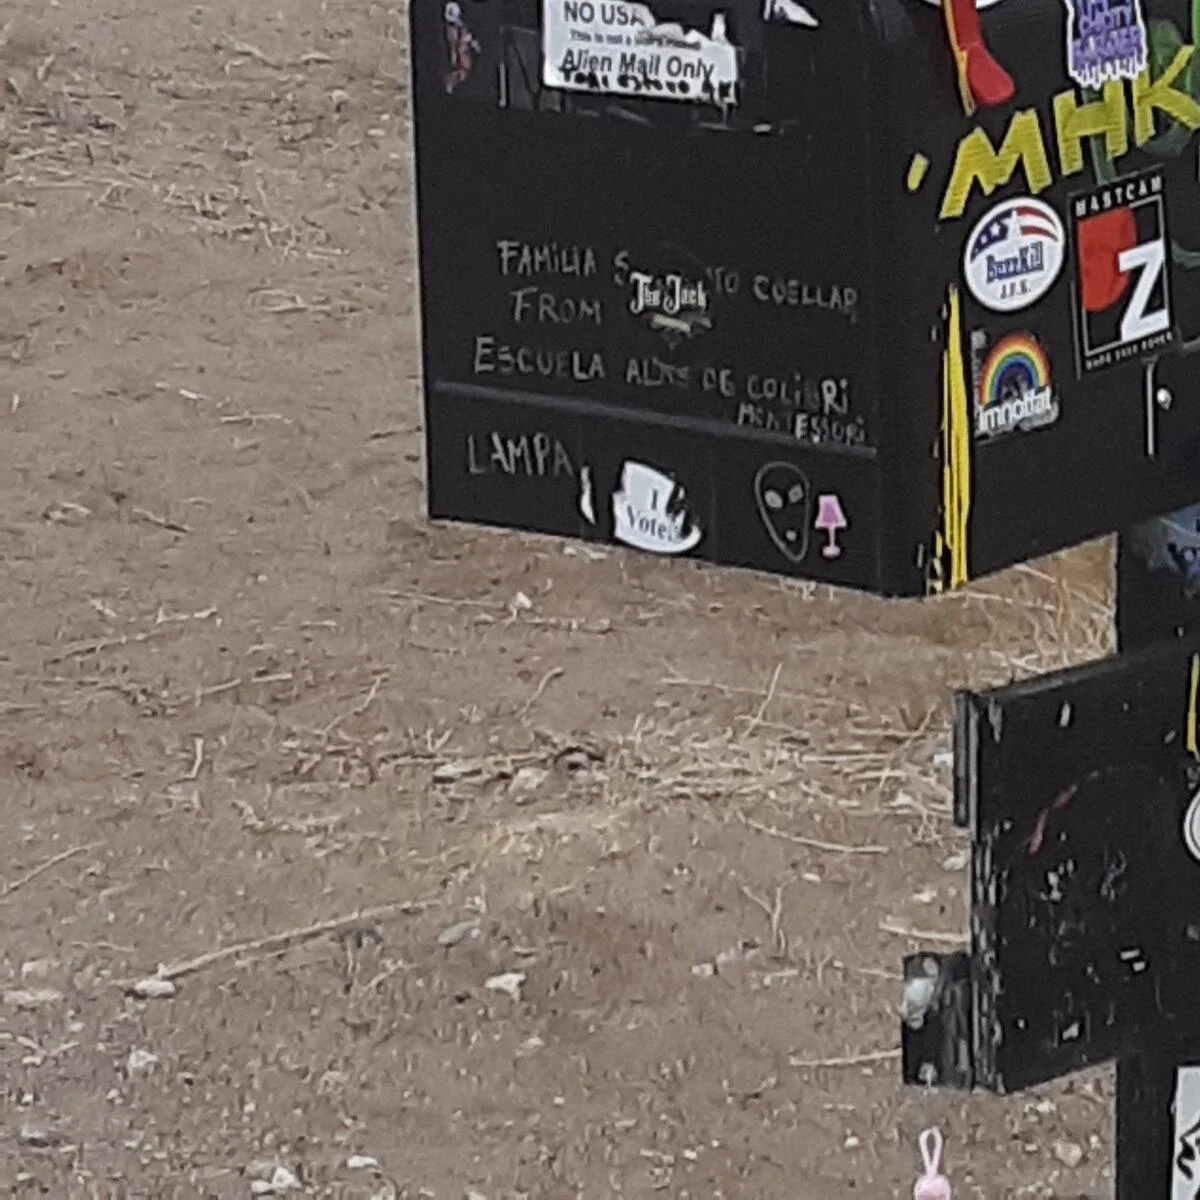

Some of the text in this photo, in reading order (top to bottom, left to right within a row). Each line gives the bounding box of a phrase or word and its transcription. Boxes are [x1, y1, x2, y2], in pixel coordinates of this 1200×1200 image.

[563, 0, 595, 24] NO
[563, 48, 612, 73] Alien
[620, 52, 661, 77] Mail
[666, 55, 714, 86] Only
[1075, 175, 1163, 217] MASTCAM
[511, 286, 601, 324] FROM
[1118, 238, 1170, 342] Z
[475, 337, 606, 380] ESCUELA
[467, 432, 574, 477] LAMPA
[651, 489, 658, 511] I
